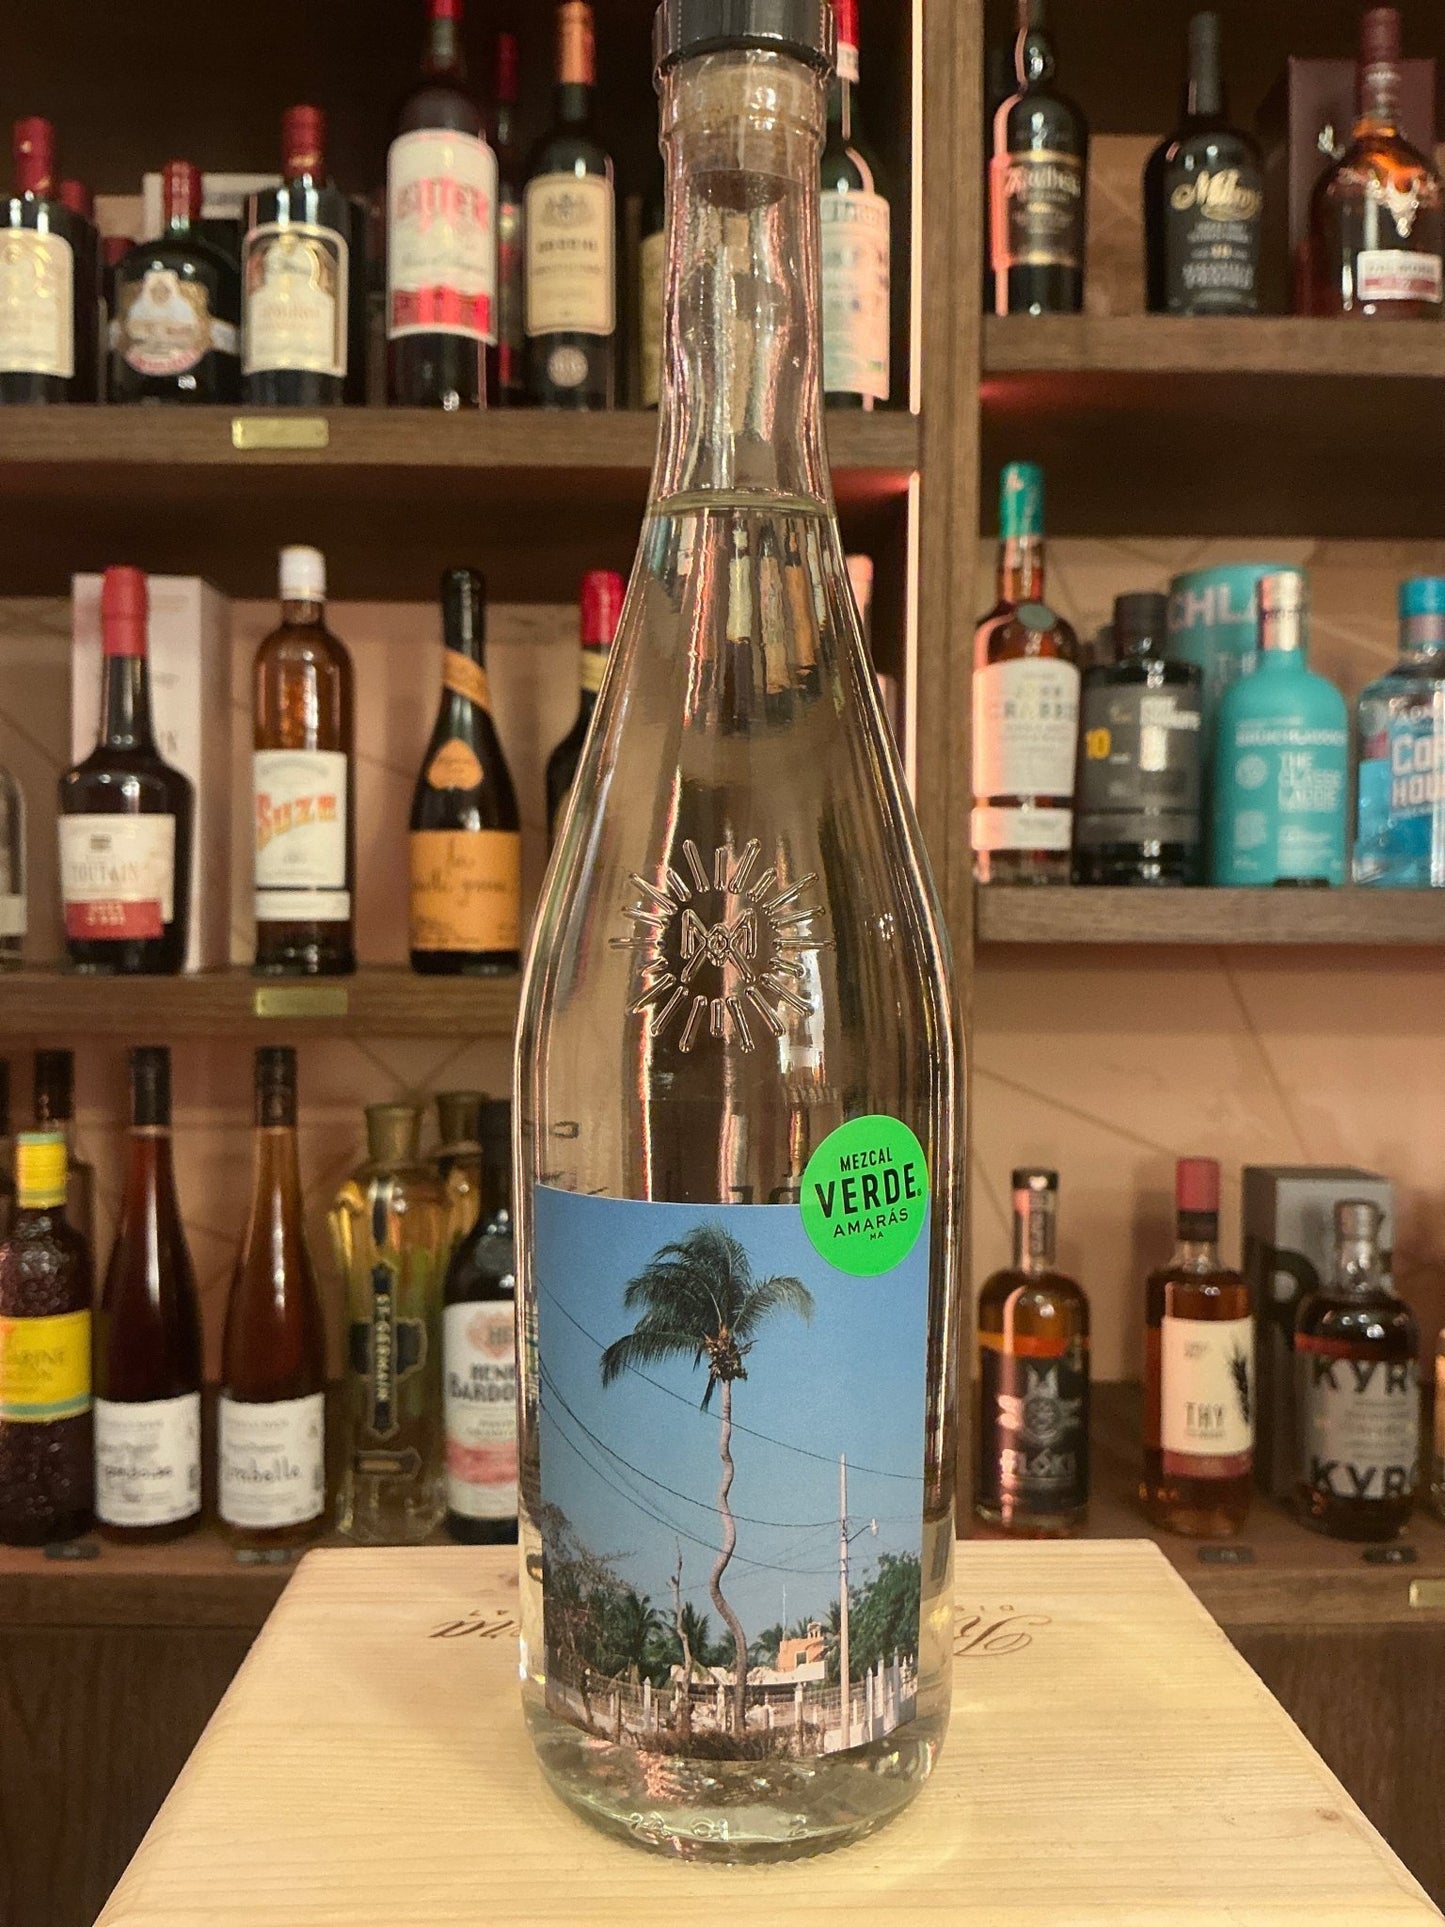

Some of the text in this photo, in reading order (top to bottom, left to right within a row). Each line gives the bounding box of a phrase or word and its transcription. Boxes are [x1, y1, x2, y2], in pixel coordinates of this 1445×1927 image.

[1086, 728, 1111, 759] 10
[840, 1147, 892, 1172] MEZCAL
[814, 1162, 918, 1219] VERDE
[833, 1207, 909, 1239] AMARÁS
[869, 1231, 884, 1241] MA
[1311, 1358, 1413, 1397] KYR
[1311, 1455, 1413, 1497] KYR
